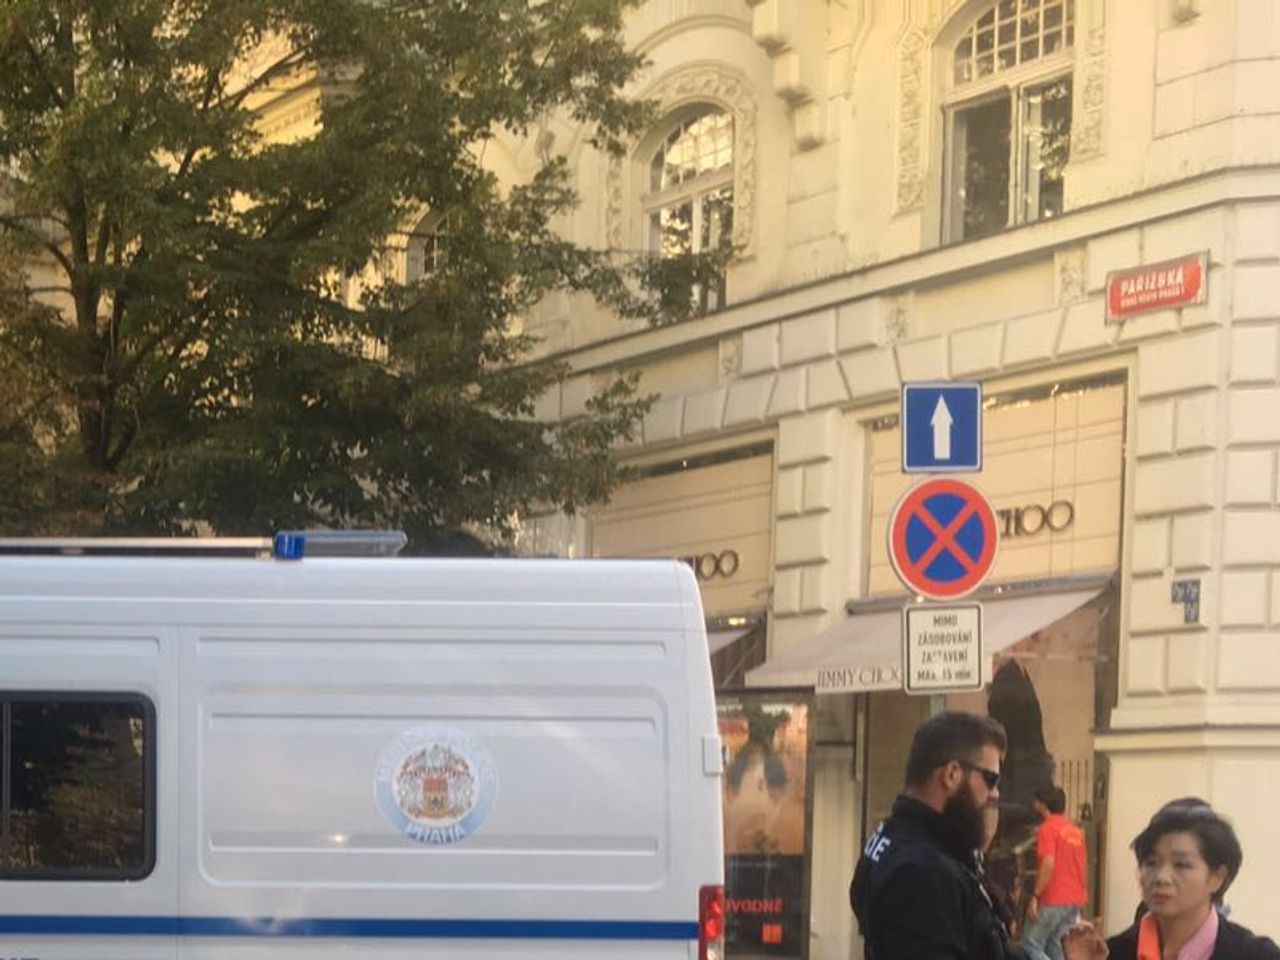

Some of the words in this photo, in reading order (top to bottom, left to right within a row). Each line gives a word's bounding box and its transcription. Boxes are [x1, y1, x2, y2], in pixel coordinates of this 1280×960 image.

[996, 500, 1074, 538] HOO
[683, 549, 739, 580] HOO
[933, 615, 958, 626] MIMO
